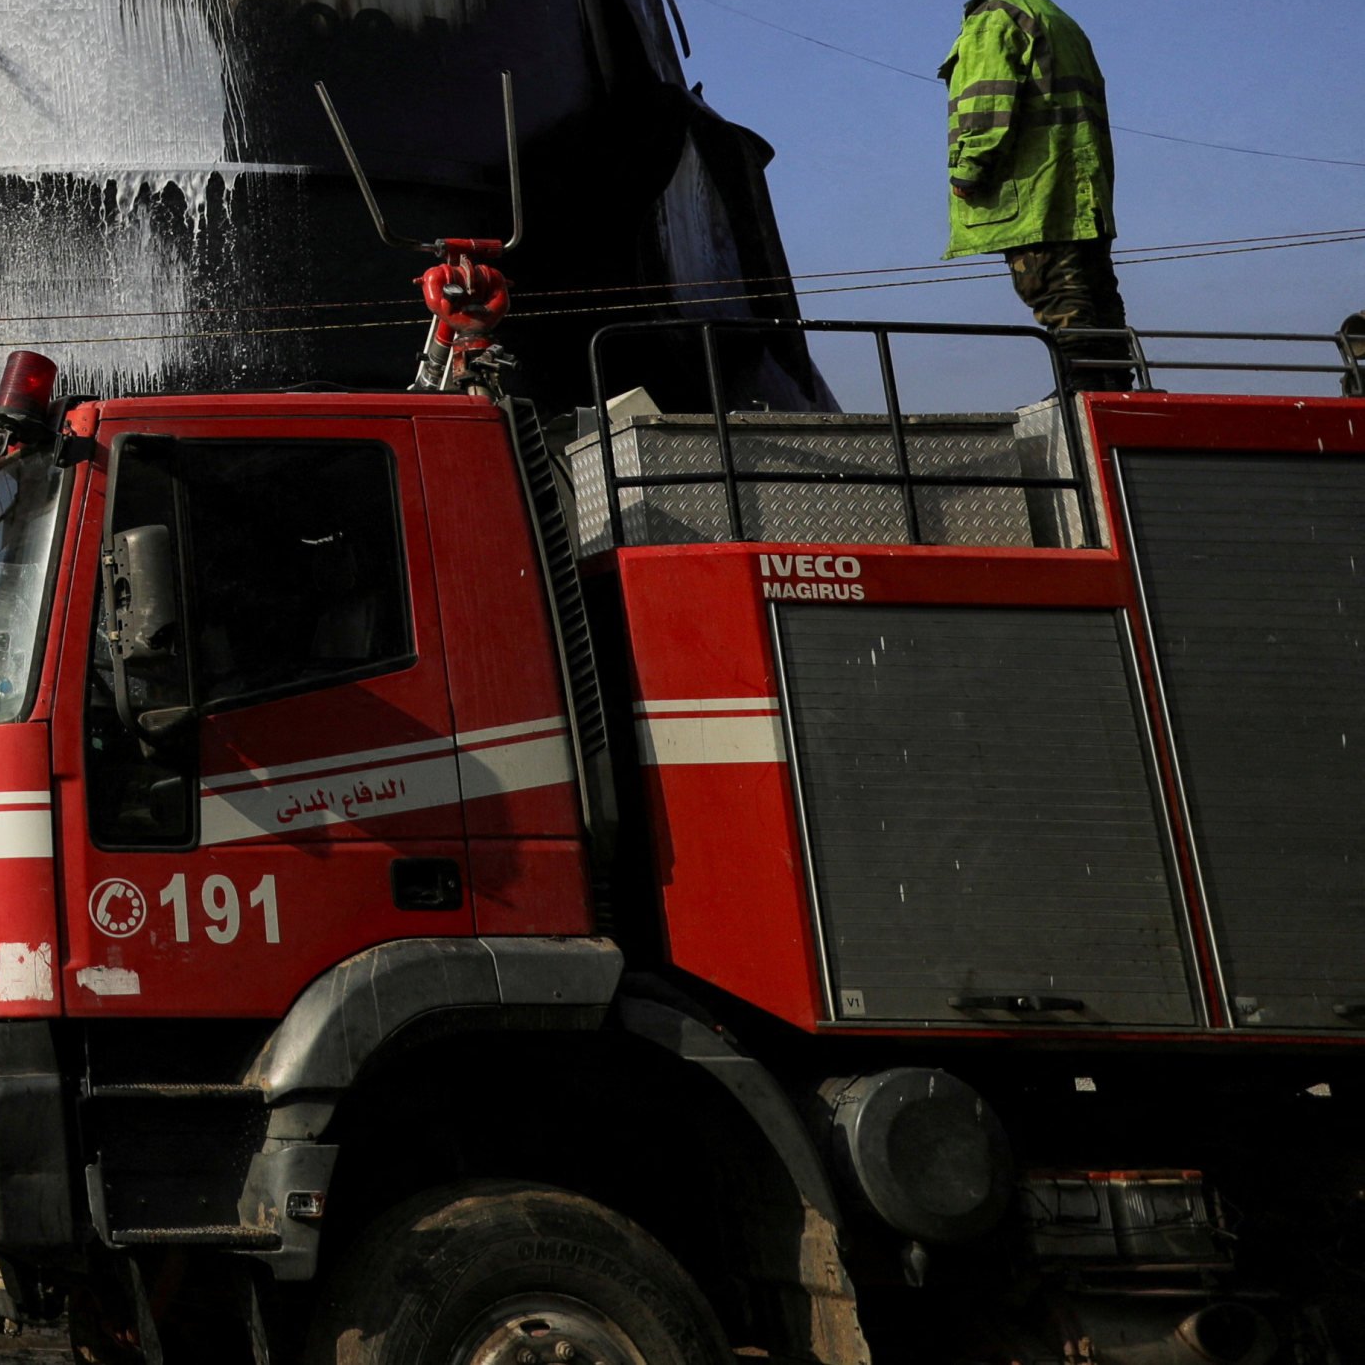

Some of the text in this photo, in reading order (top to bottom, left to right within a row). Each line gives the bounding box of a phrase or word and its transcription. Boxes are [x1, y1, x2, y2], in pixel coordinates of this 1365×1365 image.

[759, 554, 862, 579] IVECO
[762, 582, 865, 601] MAGIRUS
[341, 778, 406, 818] الدفاع
[159, 872, 281, 944] 191
[846, 997, 860, 1008] V1
